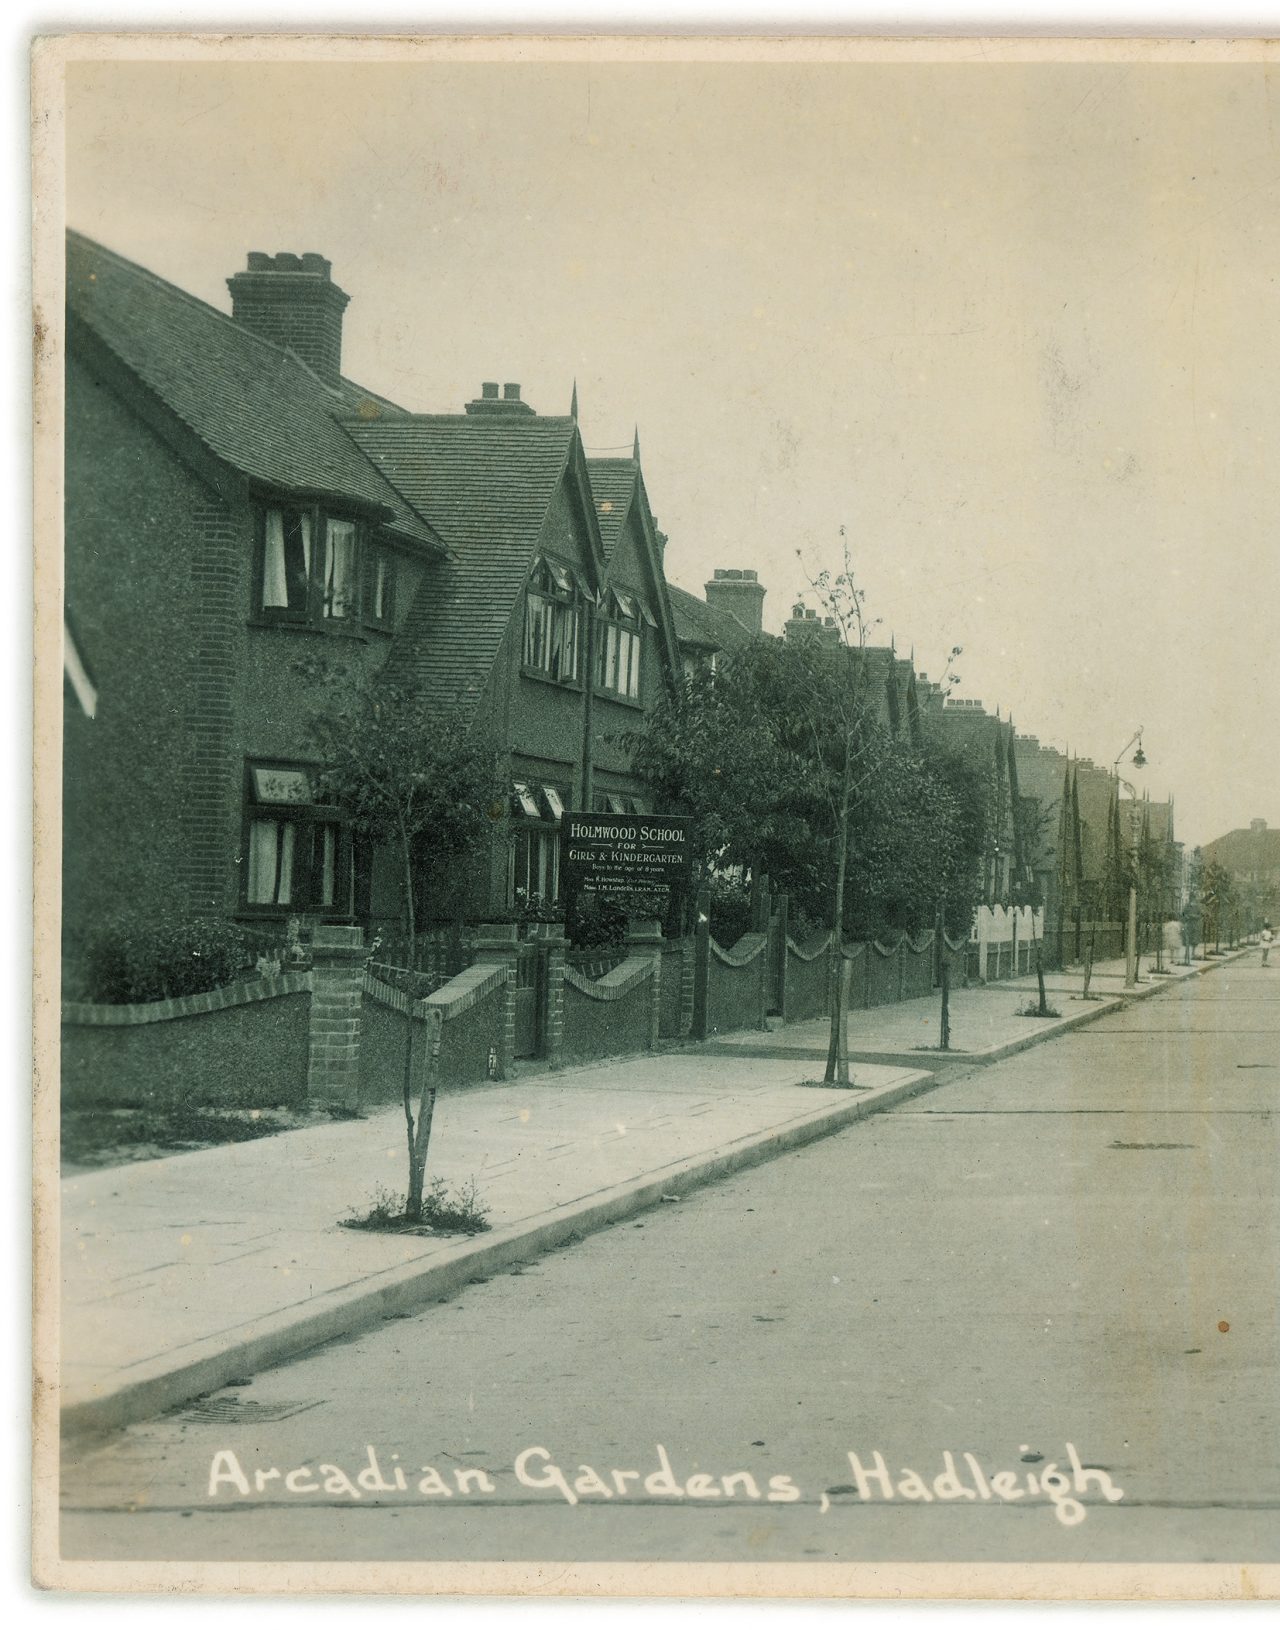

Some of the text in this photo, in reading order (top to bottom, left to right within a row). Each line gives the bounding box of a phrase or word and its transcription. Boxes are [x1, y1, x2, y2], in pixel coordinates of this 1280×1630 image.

[571, 823, 685, 842] HOLMWOOD SCHOOL
[617, 842, 637, 850] FOR
[569, 849, 683, 864] GIRLS & KINDERGARTEN
